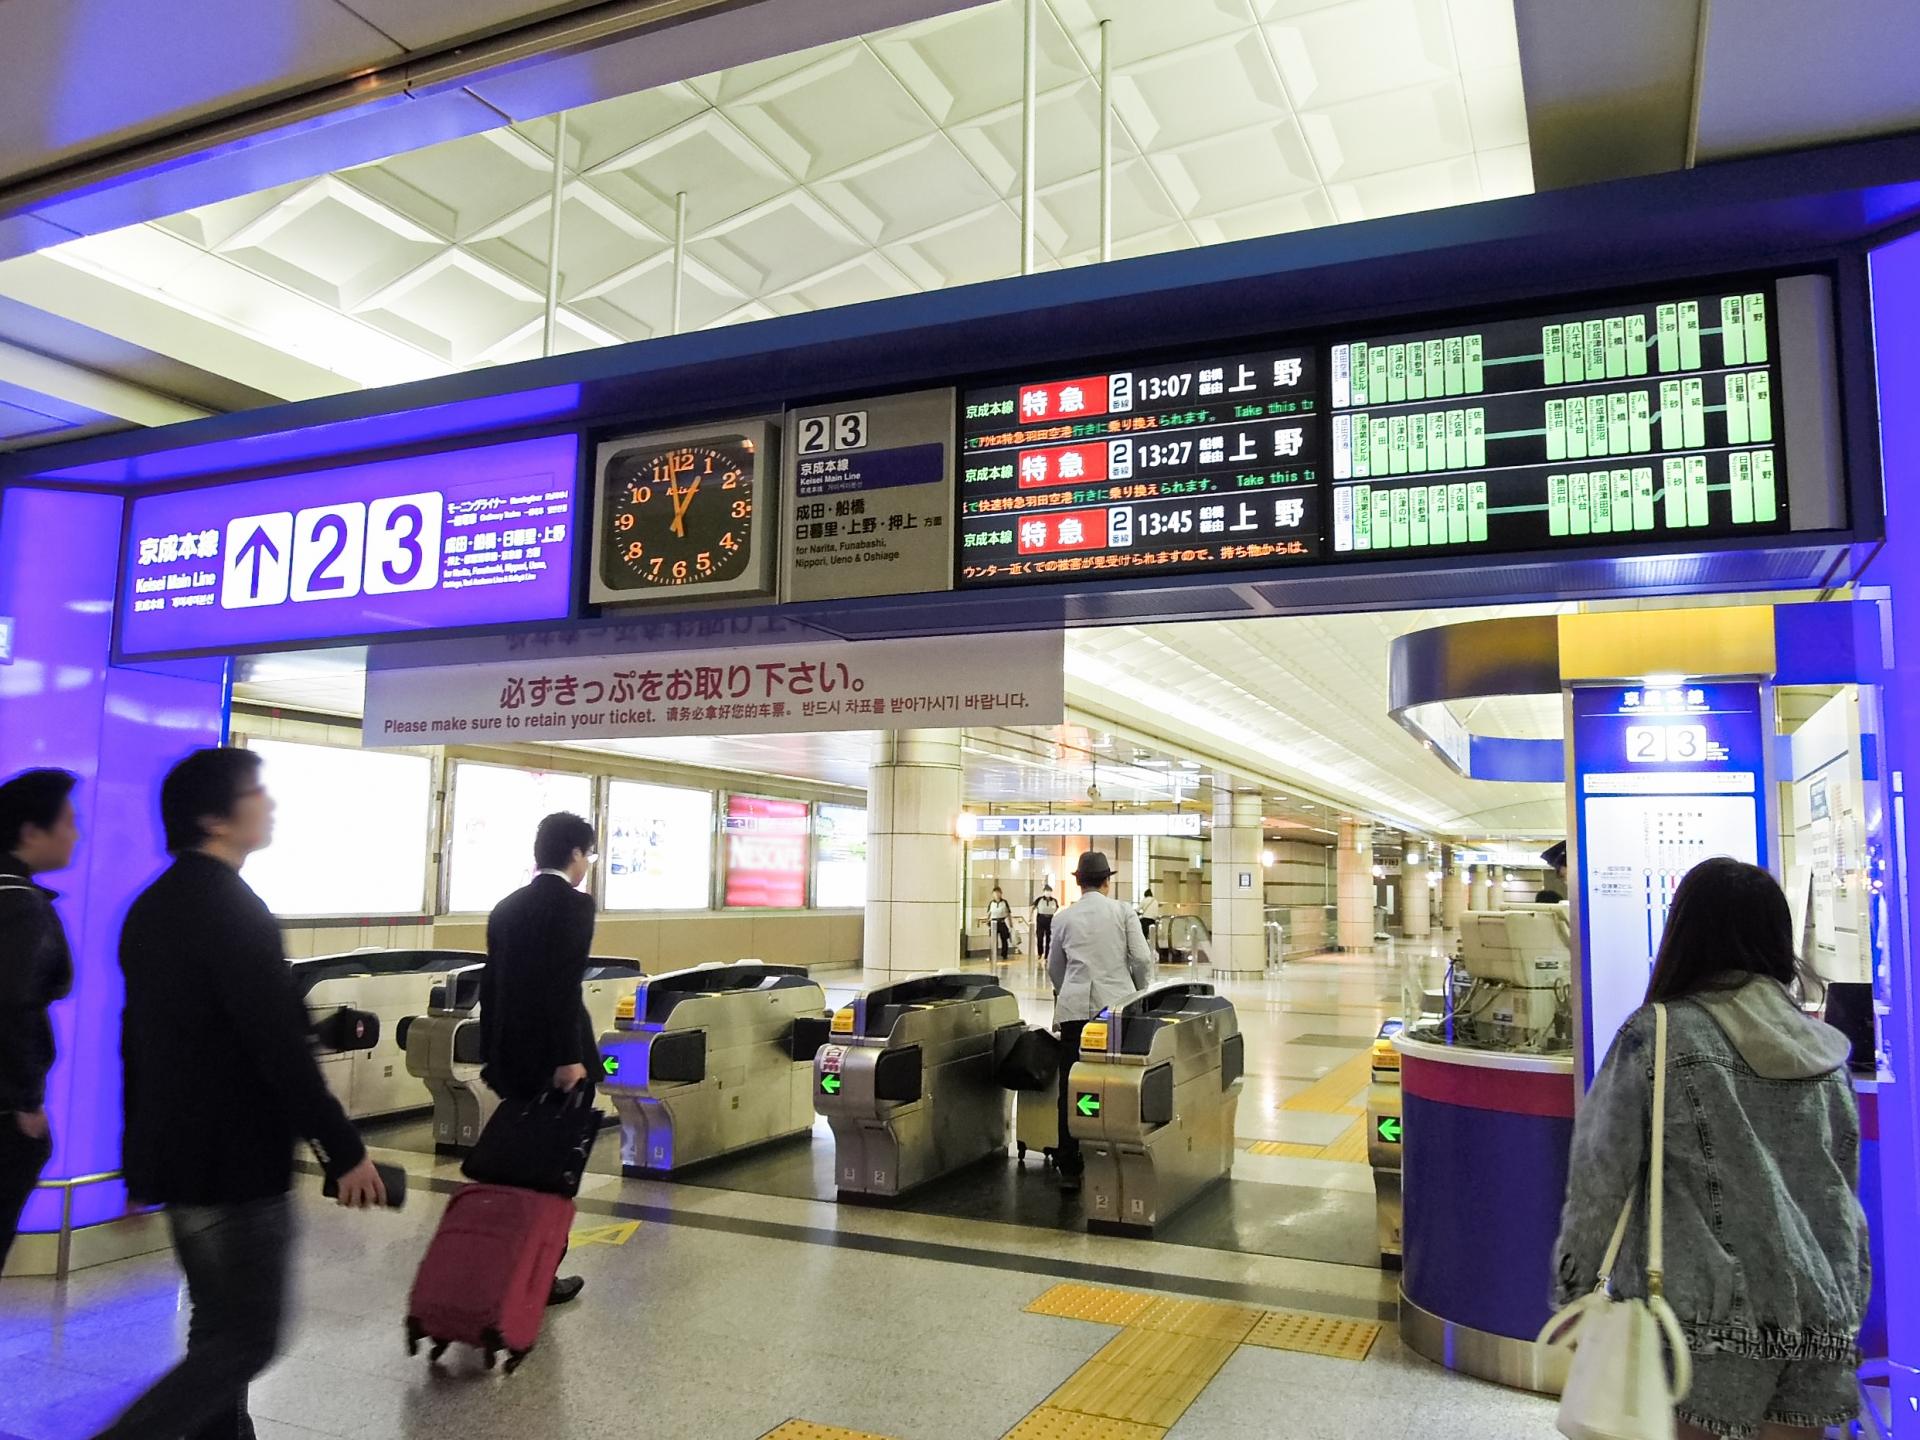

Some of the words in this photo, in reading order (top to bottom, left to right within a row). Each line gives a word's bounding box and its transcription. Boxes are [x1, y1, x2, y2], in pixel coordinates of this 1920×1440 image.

[1228, 357, 1303, 393] 上野
[1113, 378, 1128, 396] 2
[1138, 373, 1192, 401] 13:07
[966, 400, 1014, 419] 京成本線
[1022, 386, 1085, 417] 特急
[1234, 405, 1263, 418] Take
[1268, 401, 1297, 414] this
[804, 419, 824, 452] 2
[841, 414, 861, 447] 3
[1113, 443, 1128, 464] 2
[1138, 441, 1193, 468] 13:27
[1228, 427, 1303, 462] 上野
[673, 453, 694, 472] 12
[703, 457, 713, 474] 1
[800, 458, 849, 476] 京成本線
[965, 465, 1014, 483] 京成本線
[1021, 451, 1085, 482] 特急
[652, 465, 671, 483] 11
[721, 471, 737, 490] 2
[800, 476, 823, 486] Keisei
[824, 473, 842, 484] Main
[844, 471, 861, 482] Line
[1236, 475, 1265, 487] Take
[1269, 470, 1298, 484] this
[630, 486, 652, 504] 10
[731, 500, 746, 519] 3
[796, 498, 865, 522] 成田・船橋
[1229, 498, 1304, 531] 上野
[619, 513, 635, 531] 9
[796, 512, 918, 541] 日暮里・上野・押上
[923, 515, 943, 528] 方面
[1113, 511, 1128, 531] 2
[1138, 509, 1193, 536] 13:45
[719, 532, 734, 549] 4
[963, 530, 1013, 547] 京成本線
[1021, 518, 1084, 548] 特急
[138, 529, 219, 566] 京成本線
[306, 512, 349, 593] 2
[381, 503, 424, 585] 3
[628, 541, 644, 559] 8
[796, 544, 808, 555] for
[809, 542, 837, 554] Narita,
[839, 537, 887, 551] Funabashi,
[649, 557, 664, 576] 7
[671, 560, 687, 578] 6
[696, 551, 711, 571] 5
[795, 556, 828, 568] Nippori,
[830, 553, 852, 566] Ueno
[854, 553, 862, 563] &
[863, 550, 900, 563] Oshiage
[135, 575, 167, 594] Keisei
[166, 572, 192, 590] Main
[192, 570, 216, 587] Line
[500, 661, 865, 709] 必ずきっぷをお取り下さい。
[666, 701, 792, 722] 请务必拿好您的车票。
[802, 699, 841, 717] 반드시
[845, 697, 886, 715] 차표를
[890, 694, 960, 714] 받아가시기
[964, 692, 1030, 710] 바랍니다.
[384, 718, 427, 734] Please
[431, 714, 468, 732] make
[471, 716, 501, 730] sure
[506, 713, 520, 728] to
[524, 710, 567, 728] retain
[570, 710, 605, 730] your
[609, 706, 656, 725] ticket.
[1637, 731, 1656, 758] 2
[1677, 730, 1697, 758] 3
